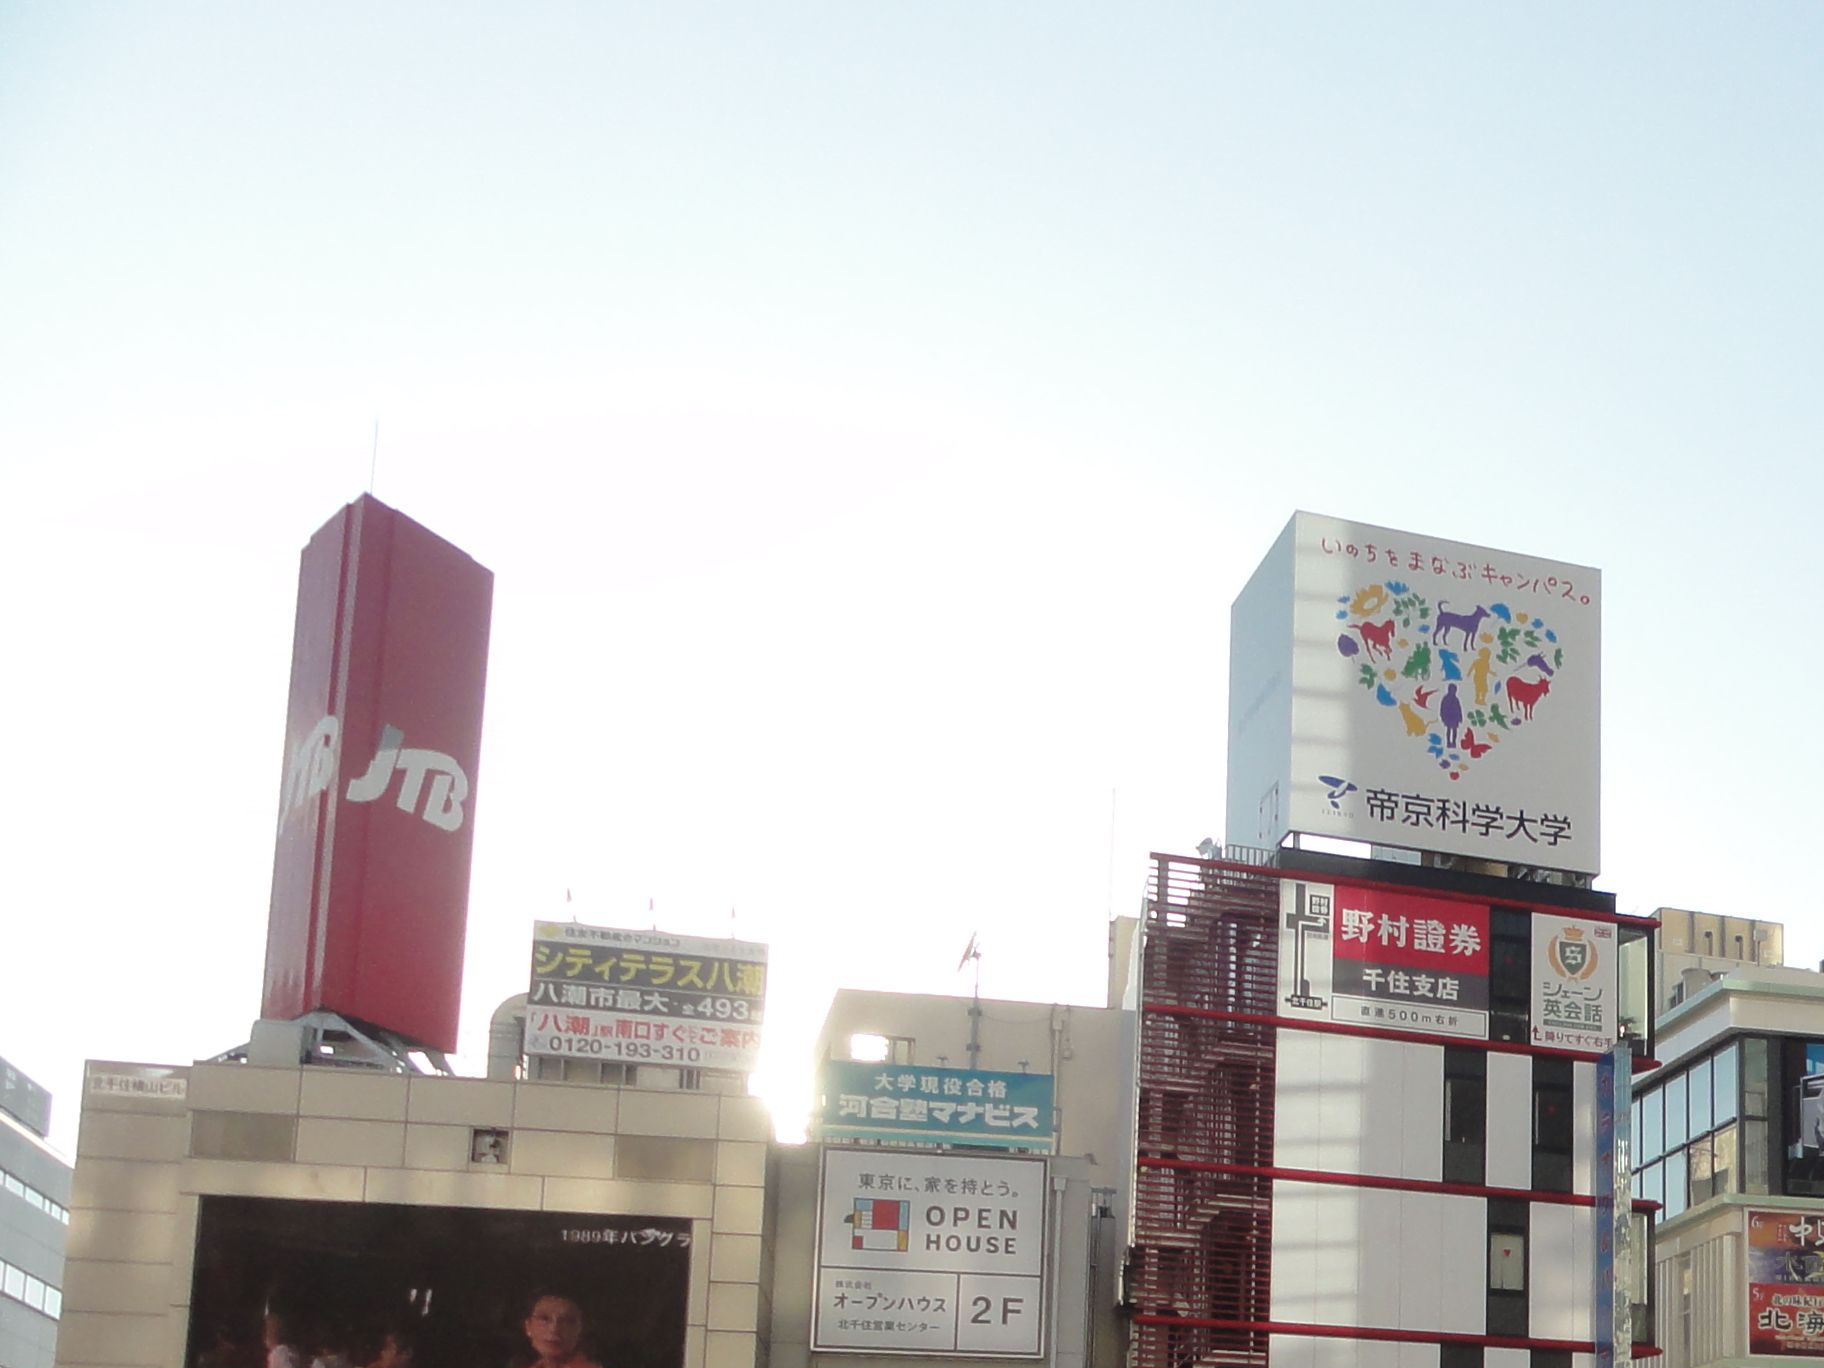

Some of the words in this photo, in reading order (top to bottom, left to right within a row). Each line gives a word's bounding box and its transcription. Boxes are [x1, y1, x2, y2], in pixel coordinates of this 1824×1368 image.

[1322, 538, 1590, 605] いのちをまなぶキャンパス。
[346, 724, 469, 832] JTB
[1366, 788, 1572, 846] 帝京科学大学
[1341, 908, 1481, 956] 野村證券
[535, 945, 764, 995] シティテラス八潮
[1362, 968, 1460, 1001] 千住支店
[1543, 982, 1602, 1001] シェーン
[1361, 1006, 1458, 1026] 直進500m右折
[1543, 999, 1602, 1022] 英会話
[550, 1035, 700, 1062] 0120-193-310
[874, 1073, 1007, 1098] 大学現役合格
[840, 1094, 1039, 1129] 河合塾マナビス
[859, 1173, 1019, 1198] 東京に、家を持とう。
[926, 1206, 1018, 1230] OPEN
[926, 1234, 1016, 1254] HOUSE
[833, 1292, 946, 1313] オープンハウス
[971, 1296, 1024, 1325] 2F
[838, 1319, 940, 1333] 北千住営業センター
